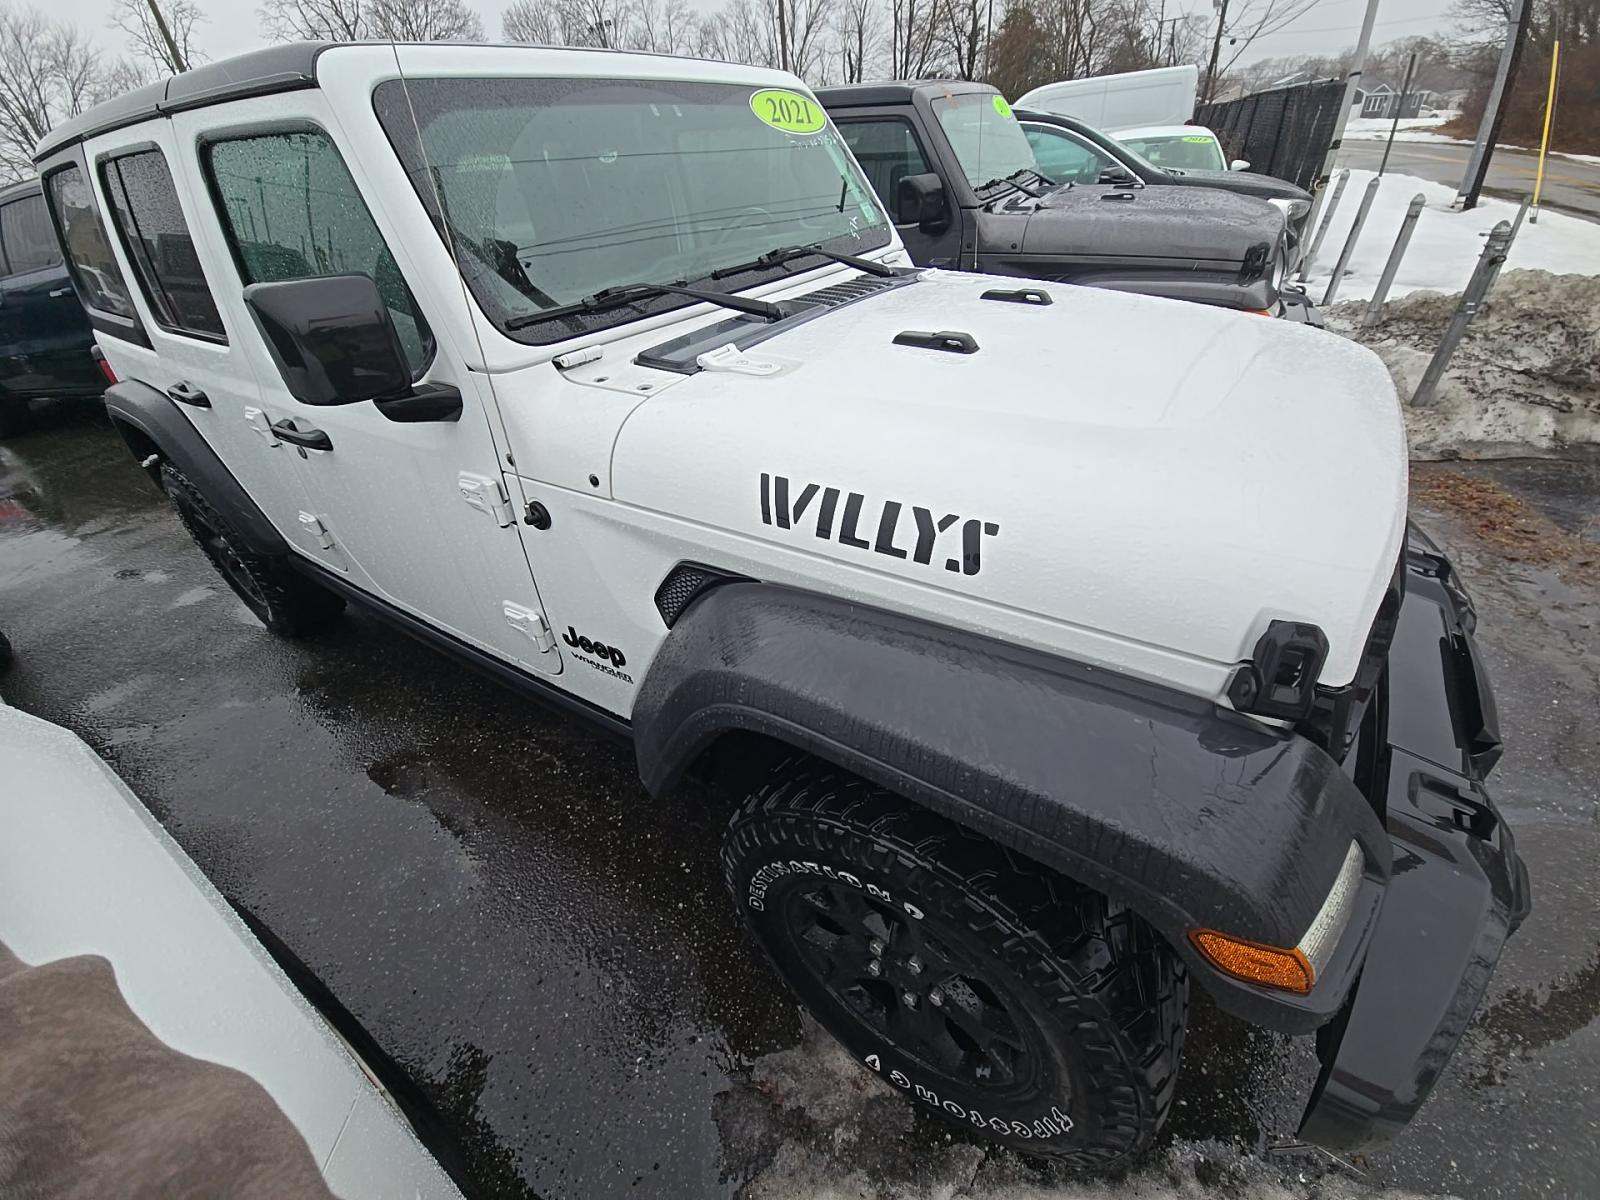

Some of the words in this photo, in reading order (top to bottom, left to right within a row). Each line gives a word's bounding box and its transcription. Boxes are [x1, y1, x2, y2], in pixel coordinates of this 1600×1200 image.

[765, 97, 813, 124] 2021
[760, 472, 1000, 576] WILLYS
[562, 625, 627, 668] Jeep
[749, 860, 892, 911] DESTINATION
